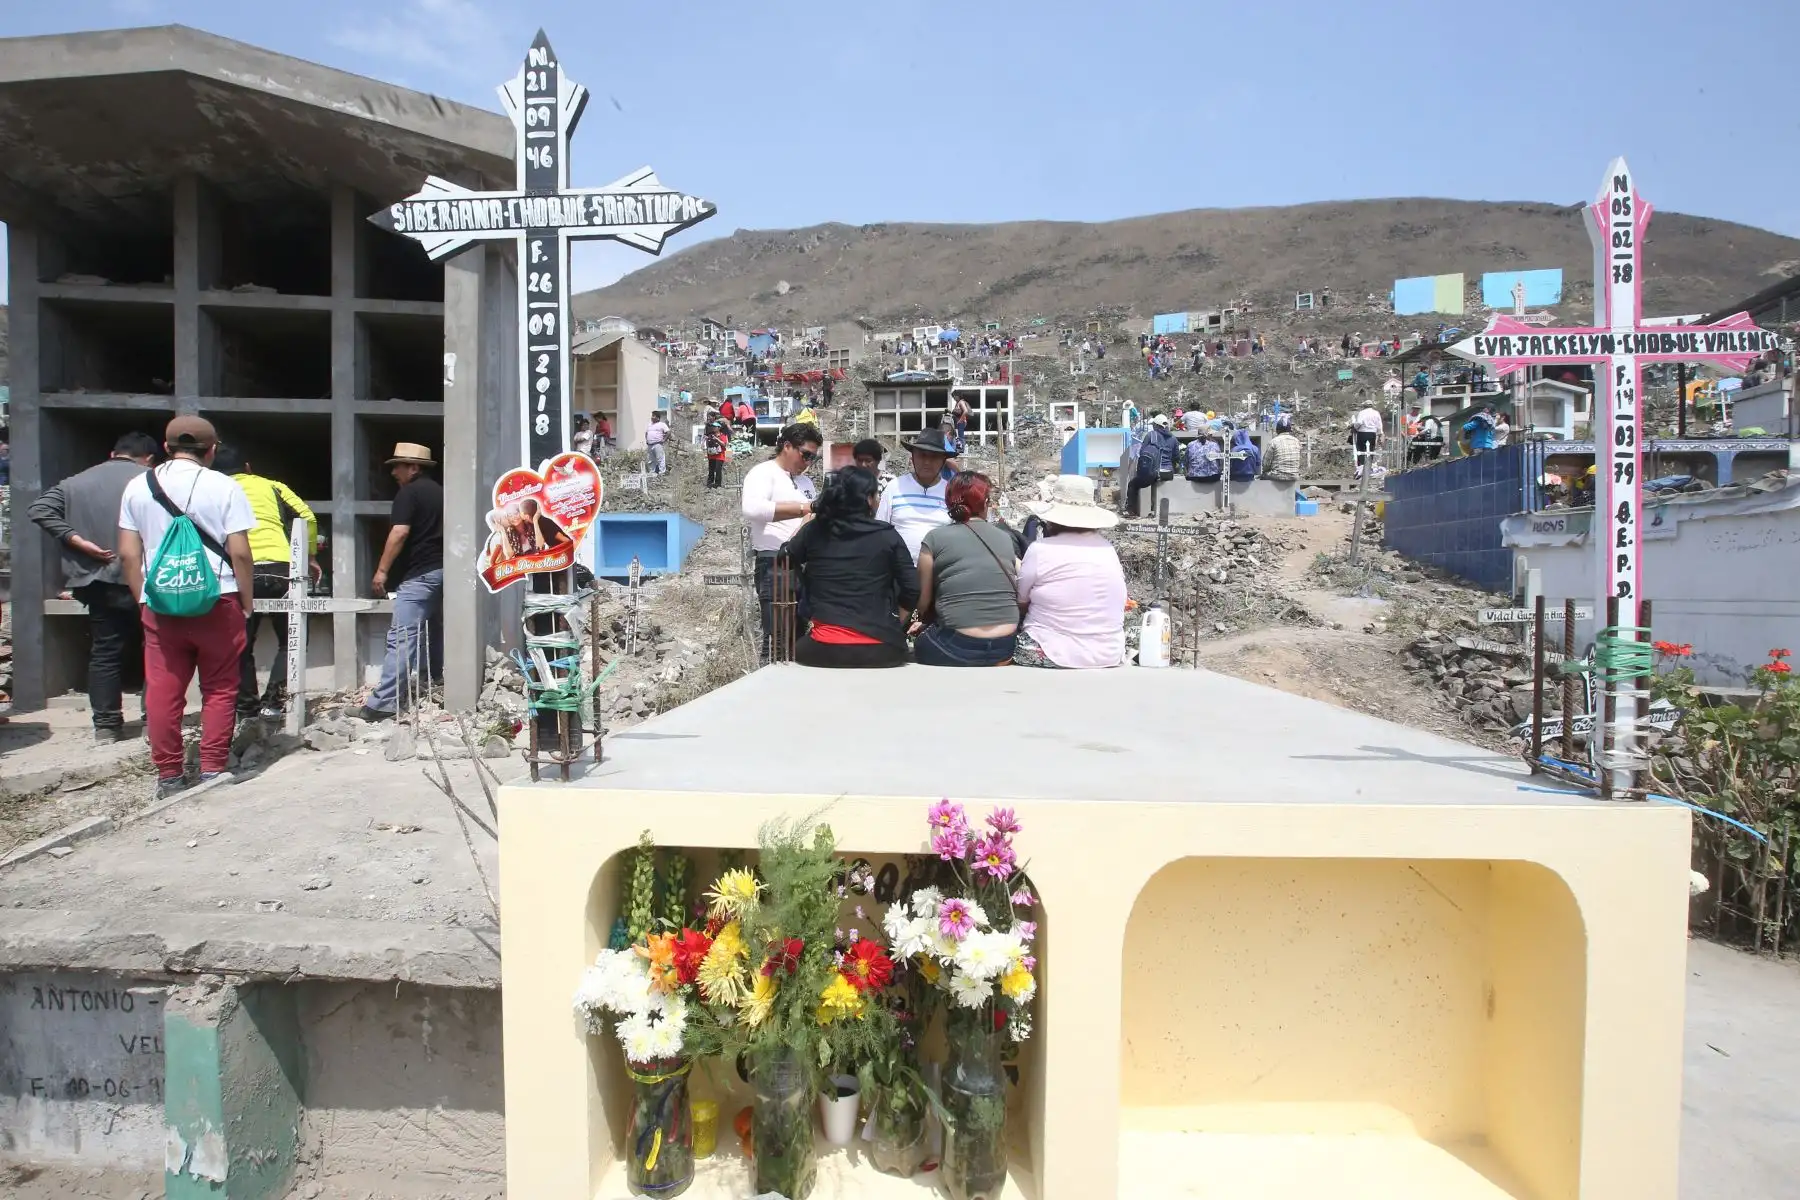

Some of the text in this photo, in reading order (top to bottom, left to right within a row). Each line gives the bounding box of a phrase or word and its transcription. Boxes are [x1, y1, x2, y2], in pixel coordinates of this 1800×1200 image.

[526, 71, 548, 91] 21
[526, 106, 551, 127] 09
[526, 144, 553, 169] 46
[1613, 174, 1628, 193] N
[1612, 196, 1632, 217] 05
[1612, 230, 1633, 249] 02
[528, 272, 553, 294] 26
[1612, 263, 1633, 284] 78
[528, 312, 556, 336] 09
[1474, 336, 1513, 356] EVA
[1516, 334, 1616, 355] JACKELYN
[1615, 388, 1634, 410] 14
[1614, 425, 1634, 447] 03
[1614, 462, 1634, 485] 79
[301, 600, 327, 611] QUISPE
[1486, 610, 1513, 621] Vidal
[31, 986, 135, 1013] ANTONIO
